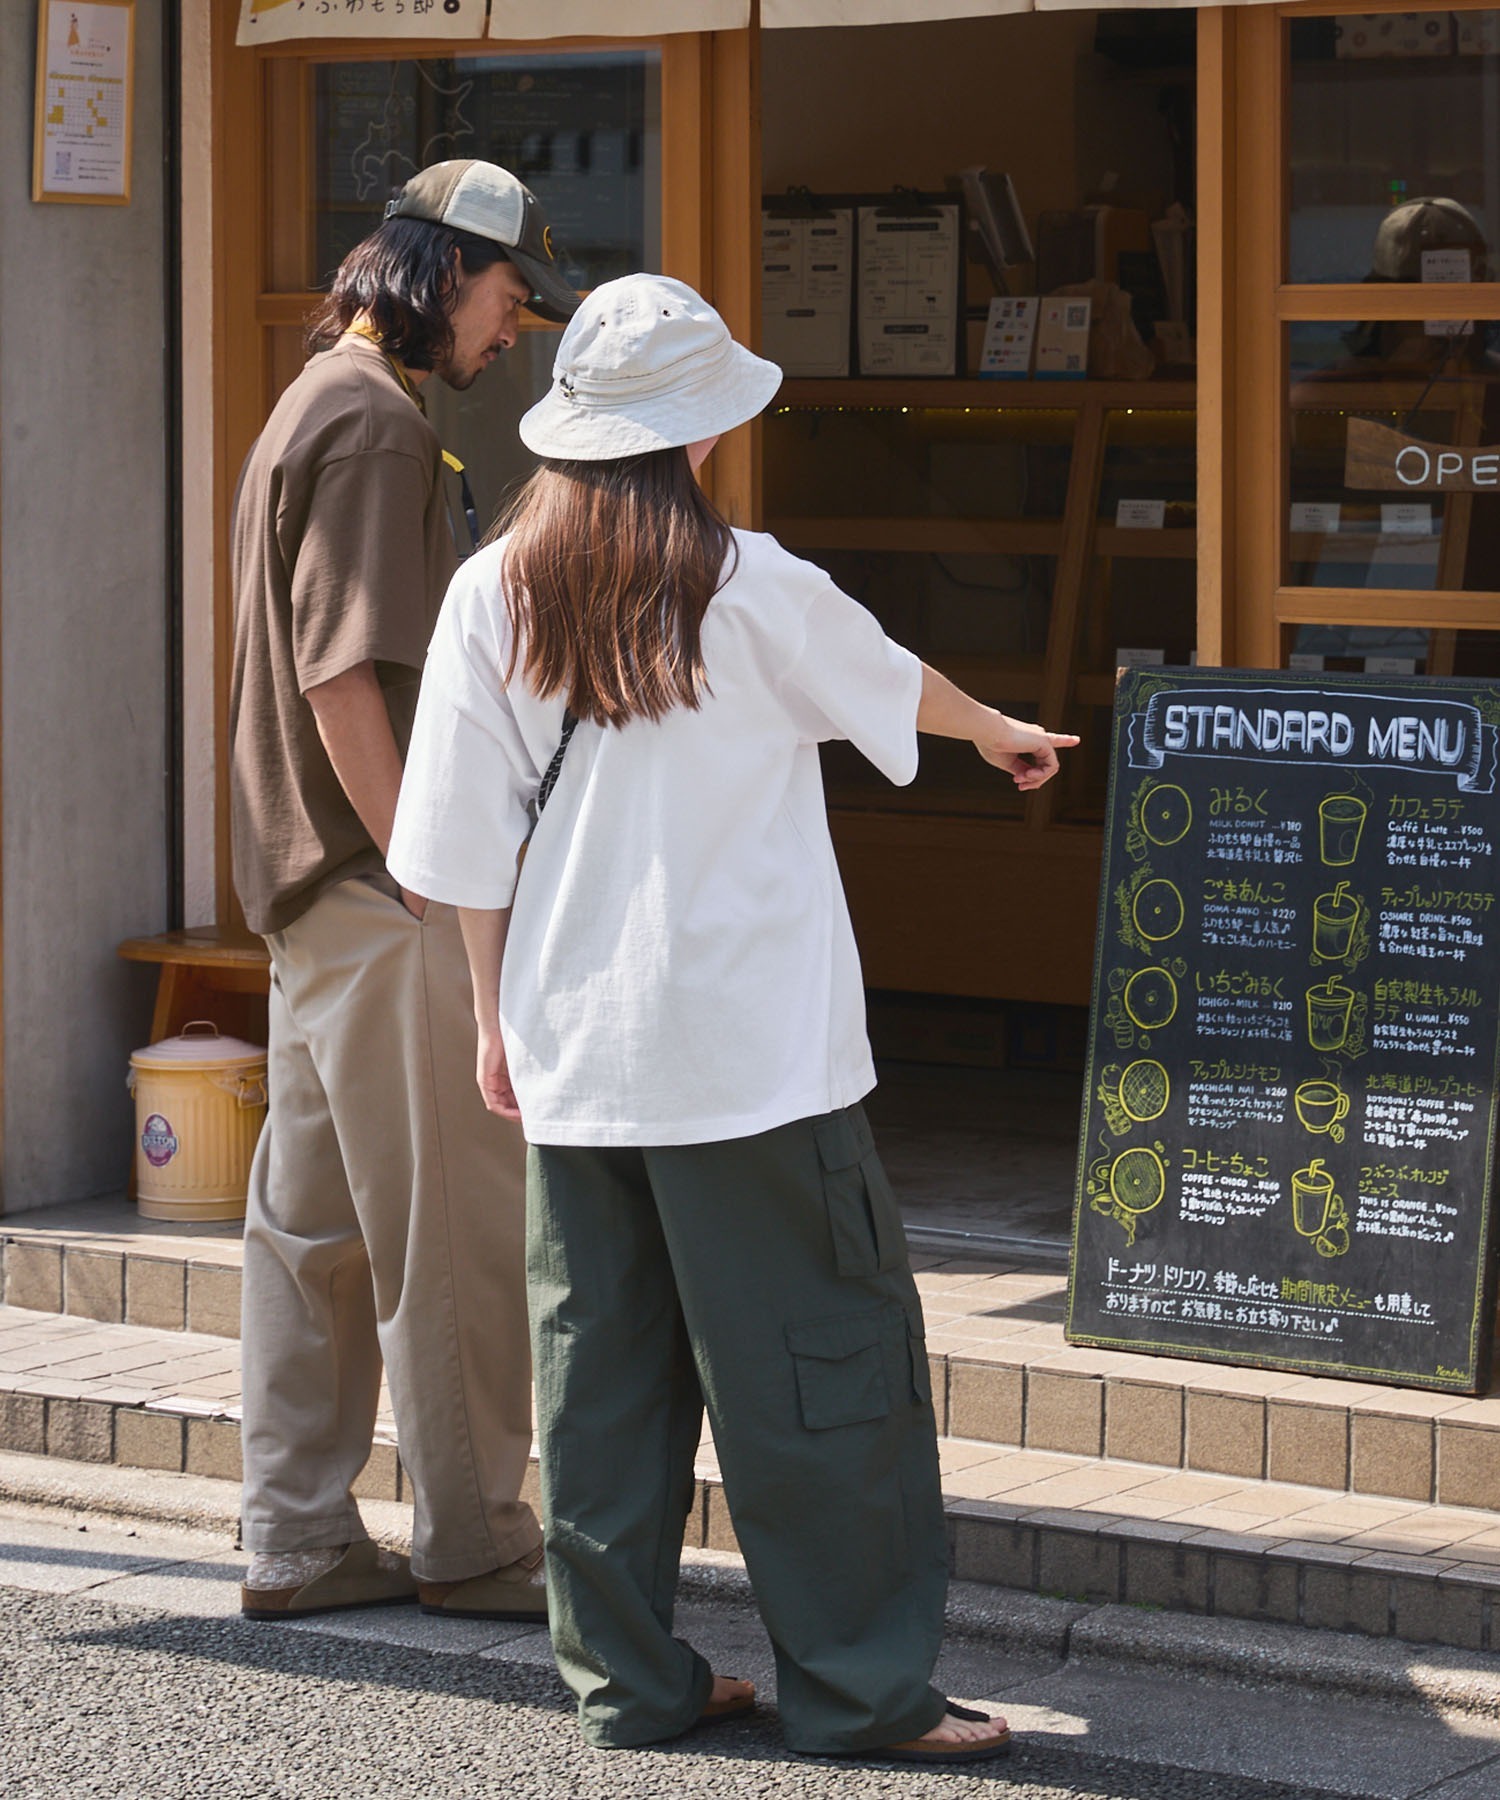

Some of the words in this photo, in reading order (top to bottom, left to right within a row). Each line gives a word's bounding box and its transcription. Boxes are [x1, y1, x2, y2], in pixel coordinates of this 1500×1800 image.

[1395, 445, 1500, 486] OPE
[1164, 705, 1353, 756] STANDARD
[1368, 717, 1466, 765] MENU
[1210, 787, 1268, 815] みるく
[1389, 794, 1464, 819] カフェラテ
[1209, 820, 1232, 828] MILK
[1235, 820, 1266, 829] DONUT
[1424, 823, 1448, 835] Latte
[1203, 878, 1285, 903] ごまあんこ
[1380, 911, 1414, 922] OSHARE
[1420, 913, 1446, 924] DRINK
[1196, 969, 1284, 999] いちごみるく
[1374, 977, 1482, 1007] 自家製生キャラメル
[1374, 1003, 1400, 1021] ラテ
[1189, 1059, 1280, 1082] アップルシナモン
[1189, 1083, 1233, 1093] MACHIGAI
[1238, 1085, 1255, 1095] NAI
[1365, 1073, 1483, 1097] 北海道ドリップコーヒー
[1416, 1098, 1445, 1110] COFFEE
[1182, 1149, 1269, 1178] コーヒーちょこ
[1360, 1164, 1450, 1185] つぶつぶオレンジ
[1358, 1179, 1399, 1198] ジュース
[1358, 1196, 1378, 1207] THIS
[1380, 1199, 1389, 1208] IS
[1392, 1199, 1428, 1212] ORANGE
